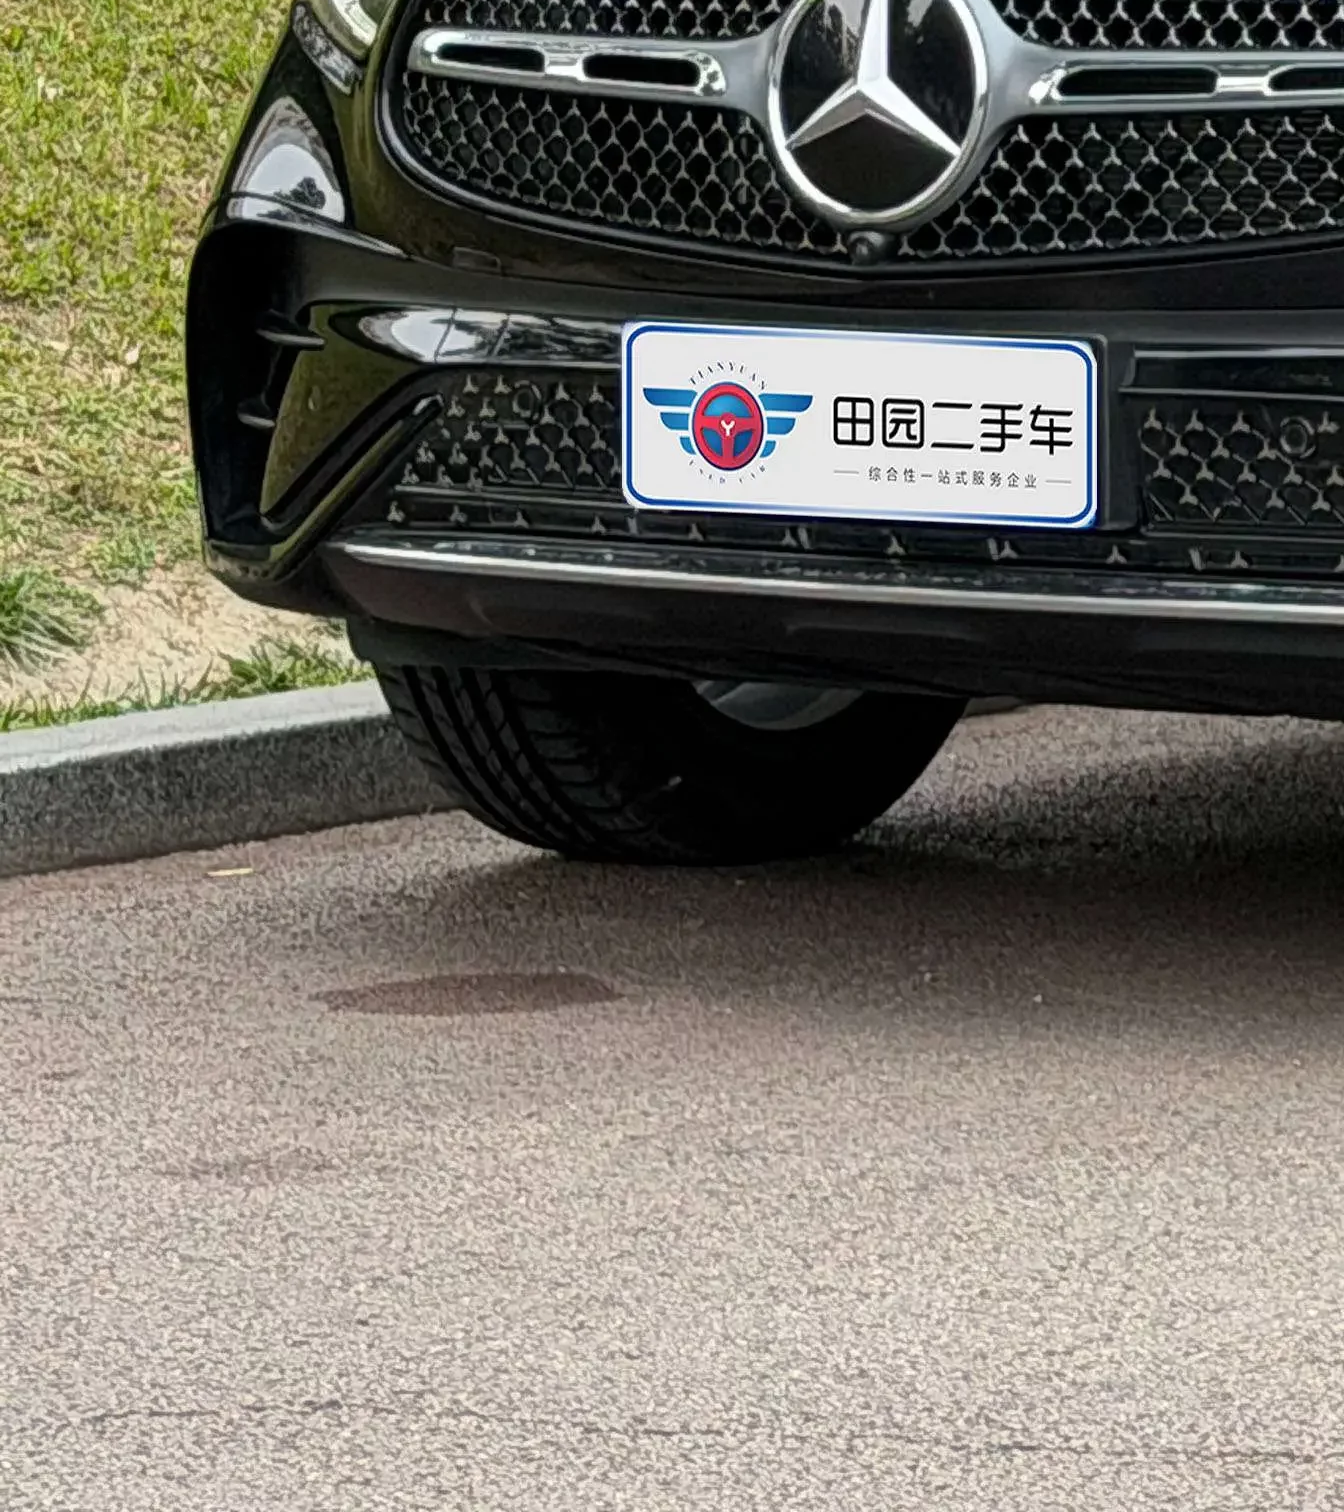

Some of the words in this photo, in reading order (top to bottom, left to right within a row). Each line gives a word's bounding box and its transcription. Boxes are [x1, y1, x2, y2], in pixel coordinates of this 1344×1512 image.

[833, 395, 1073, 455] 田园二手车
[868, 465, 1037, 488] 综合性一站式服务企业
